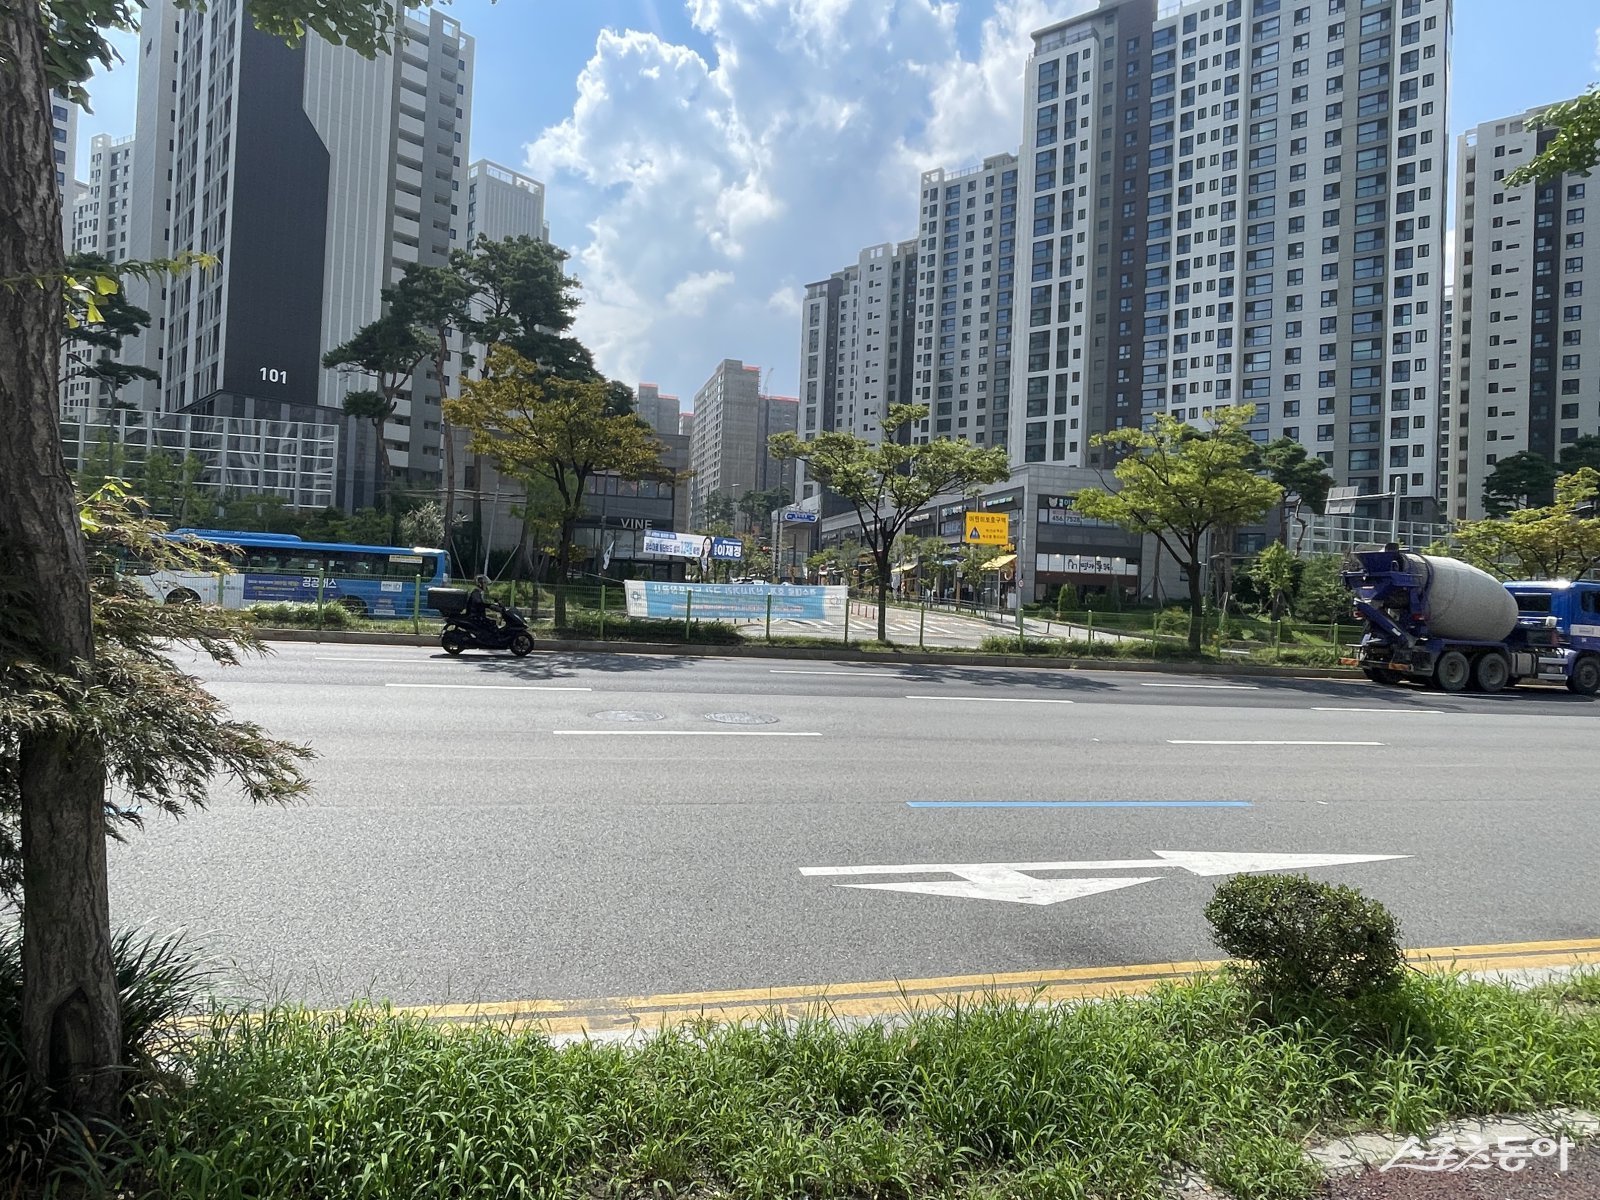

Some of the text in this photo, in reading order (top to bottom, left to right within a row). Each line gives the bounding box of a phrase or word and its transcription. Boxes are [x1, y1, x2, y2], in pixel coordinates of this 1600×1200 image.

[260, 367, 287, 385] 101
[620, 518, 653, 530] VINE
[717, 544, 742, 557] 이재정
[302, 576, 337, 588] 공공버스
